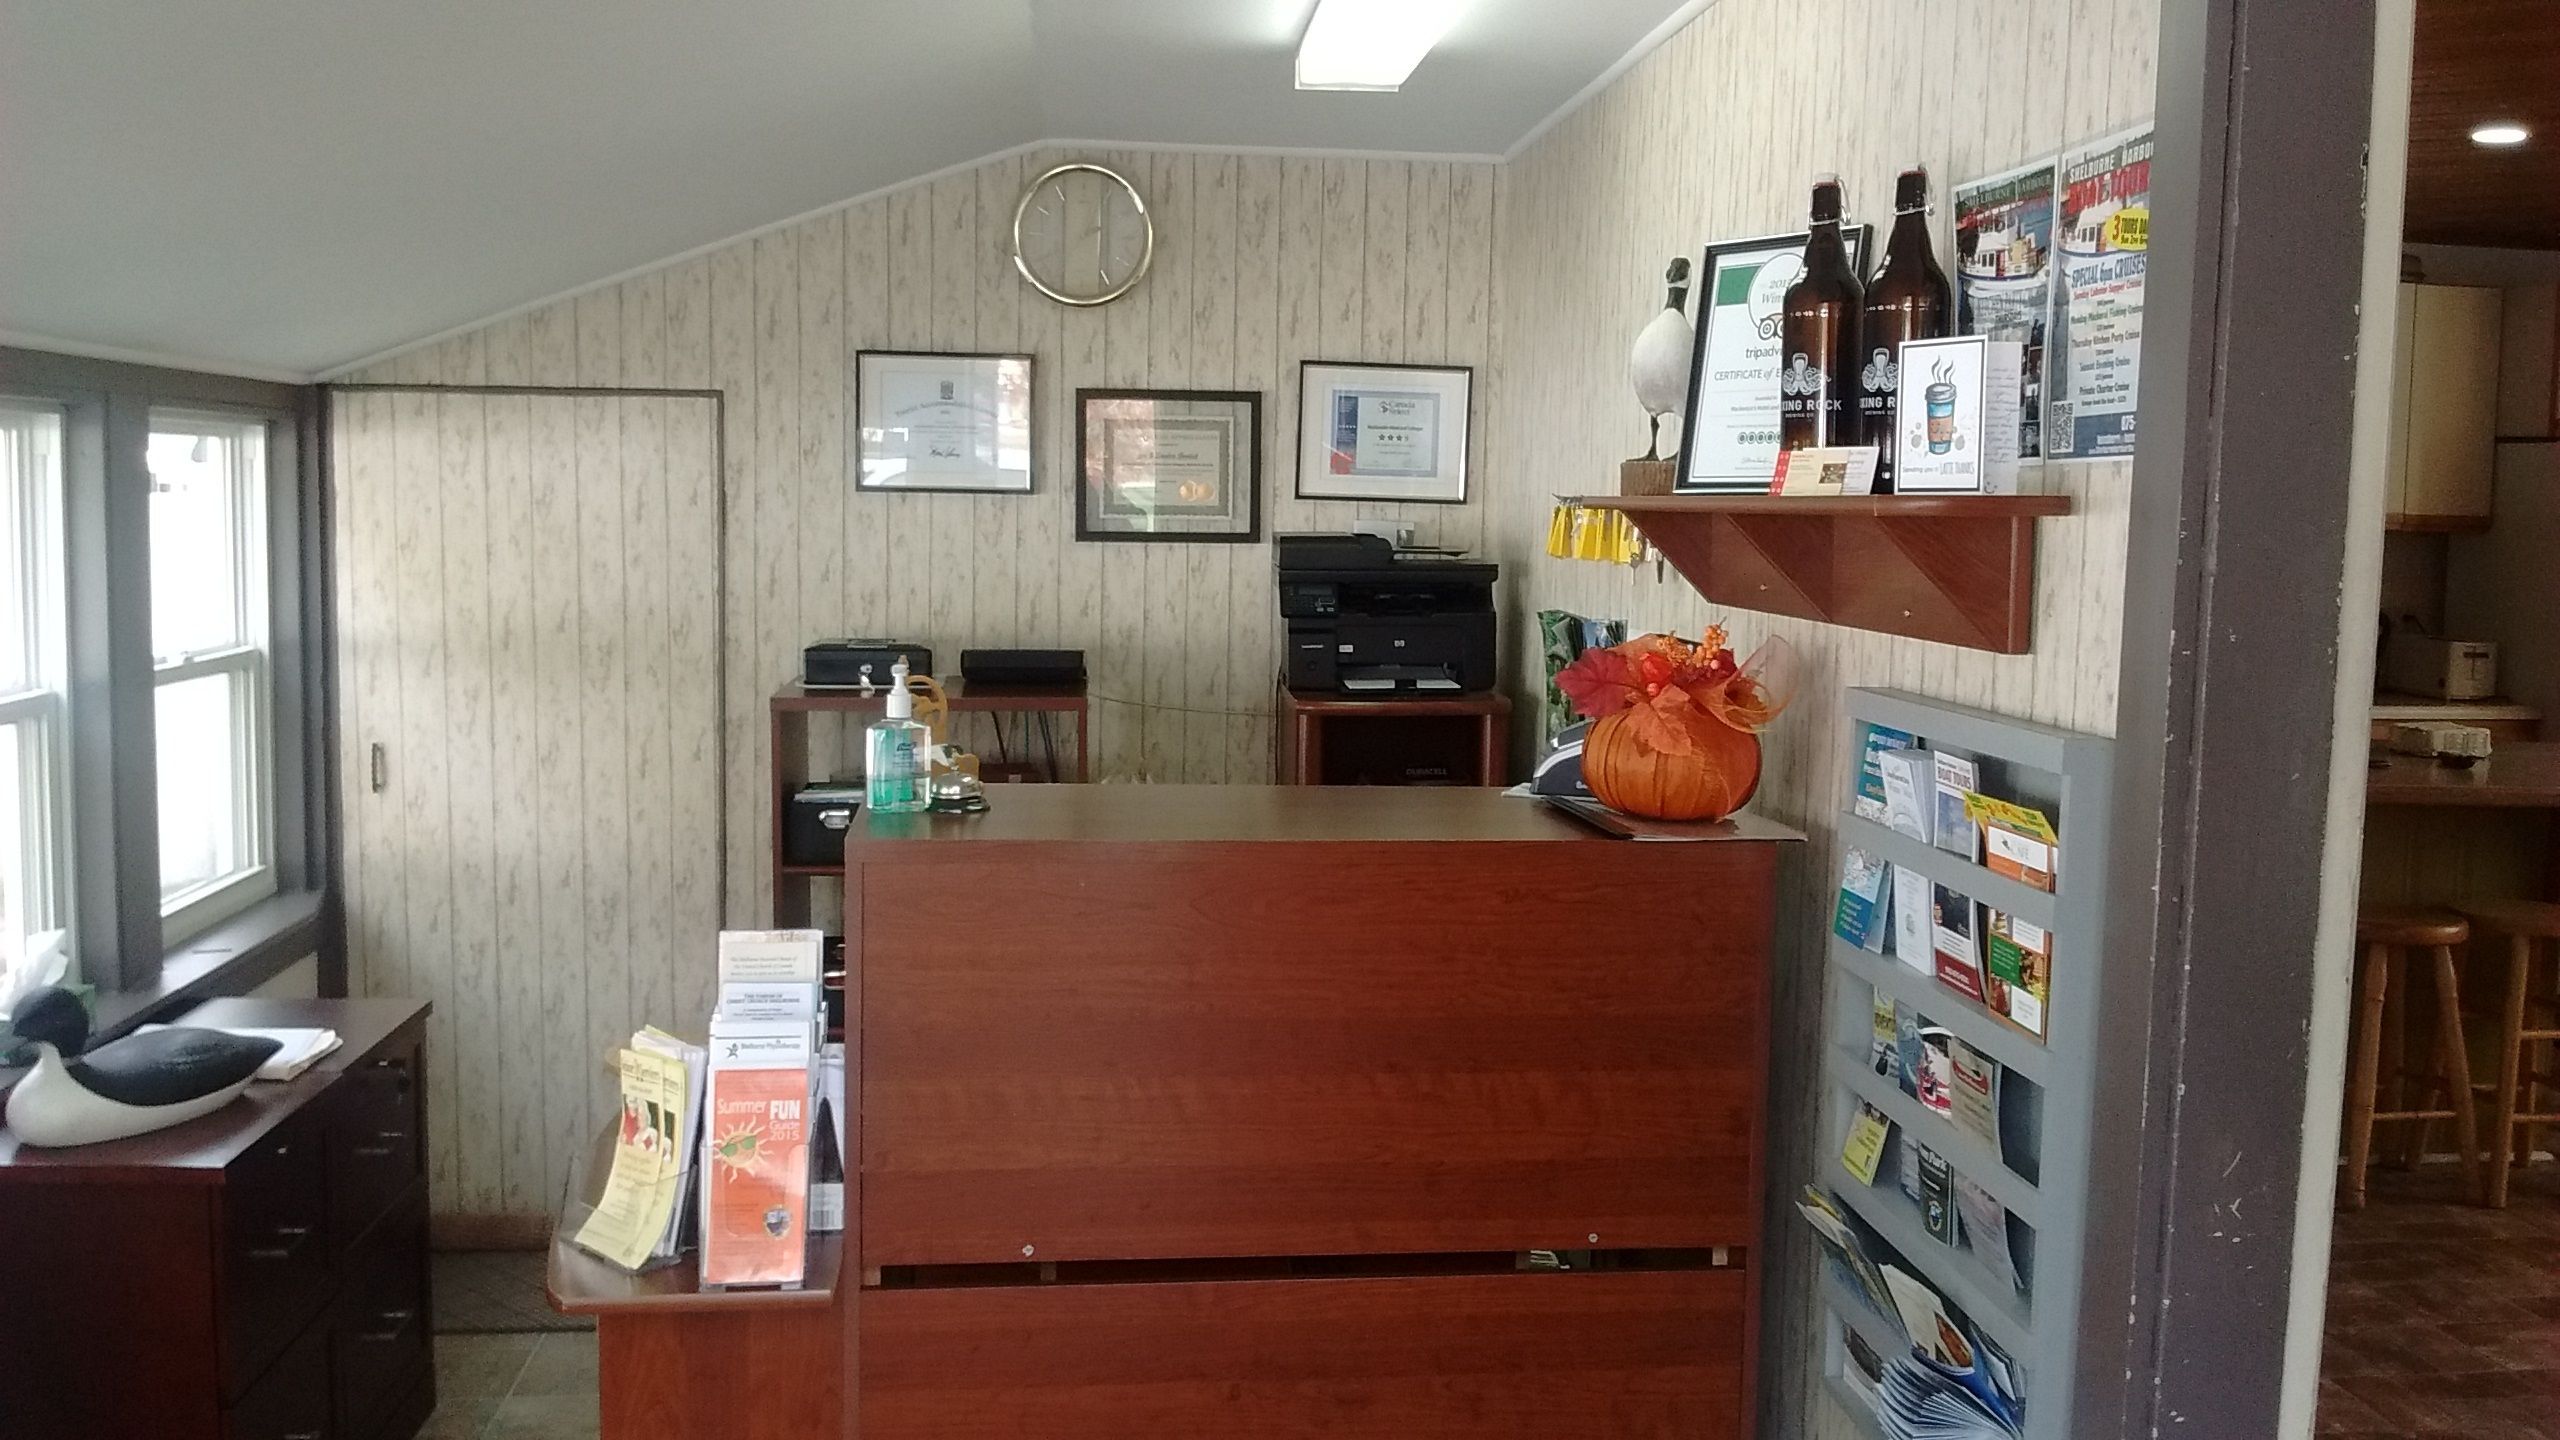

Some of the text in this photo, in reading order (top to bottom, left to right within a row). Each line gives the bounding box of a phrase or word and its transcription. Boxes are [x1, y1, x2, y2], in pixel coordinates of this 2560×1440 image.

[2069, 140, 2154, 184] SHELBURNE HARBO
[2112, 214, 2121, 241] 3
[2121, 217, 2138, 234] TOURS
[2072, 264, 2099, 288] SPECIAL
[2114, 253, 2146, 279] CRUISES
[1714, 368, 1762, 381] CERTIFICATE
[1763, 368, 1774, 380] of
[1807, 400, 1842, 412] ROCK
[1936, 765, 1953, 783] BOAT
[1953, 771, 1972, 790] TOURS
[716, 1099, 801, 1120] Summer FUN
[769, 1120, 801, 1130] Guide
[769, 1130, 801, 1141] 2015
